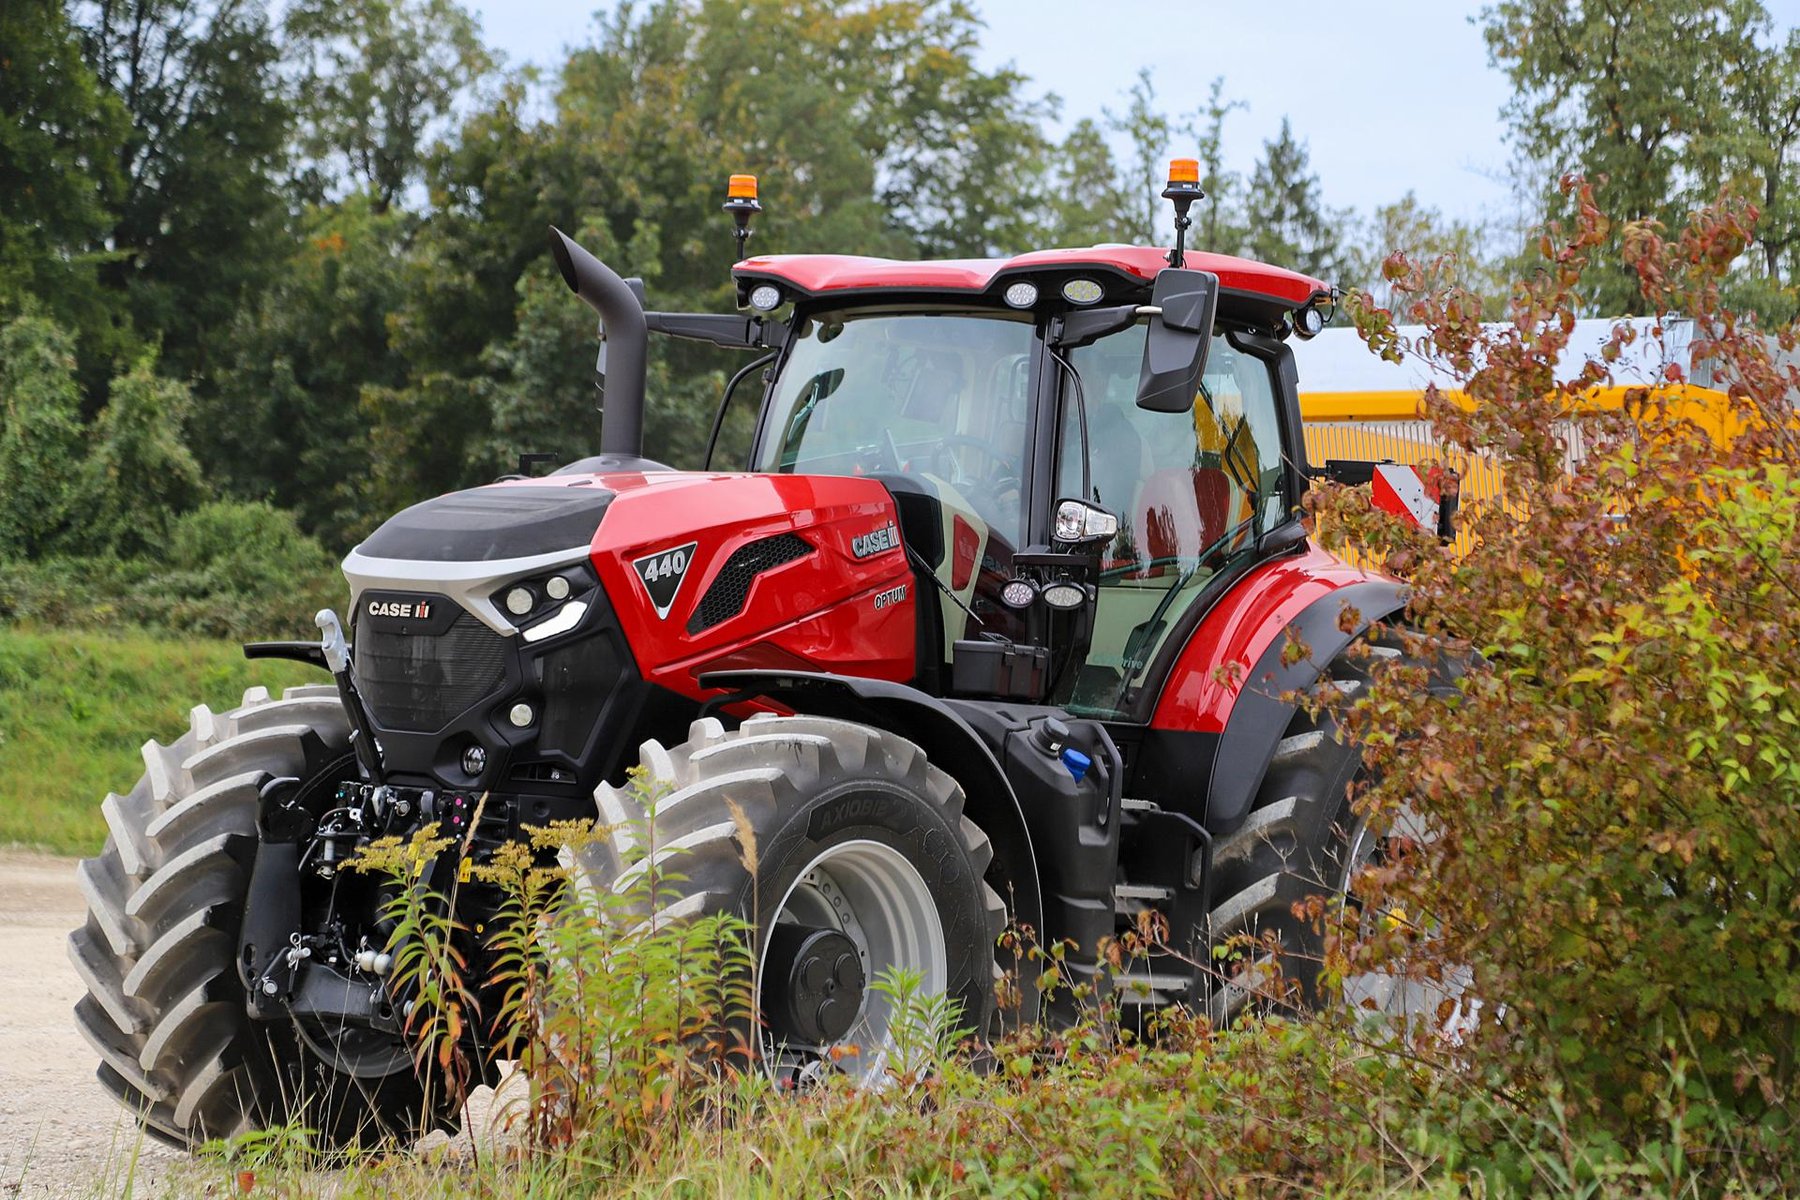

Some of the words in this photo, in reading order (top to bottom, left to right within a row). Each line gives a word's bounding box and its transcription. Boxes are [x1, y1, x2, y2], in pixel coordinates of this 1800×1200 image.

[852, 529, 889, 558] CASE
[644, 550, 686, 582] 440
[368, 601, 411, 617] CASE
[874, 584, 906, 610] OPTUM
